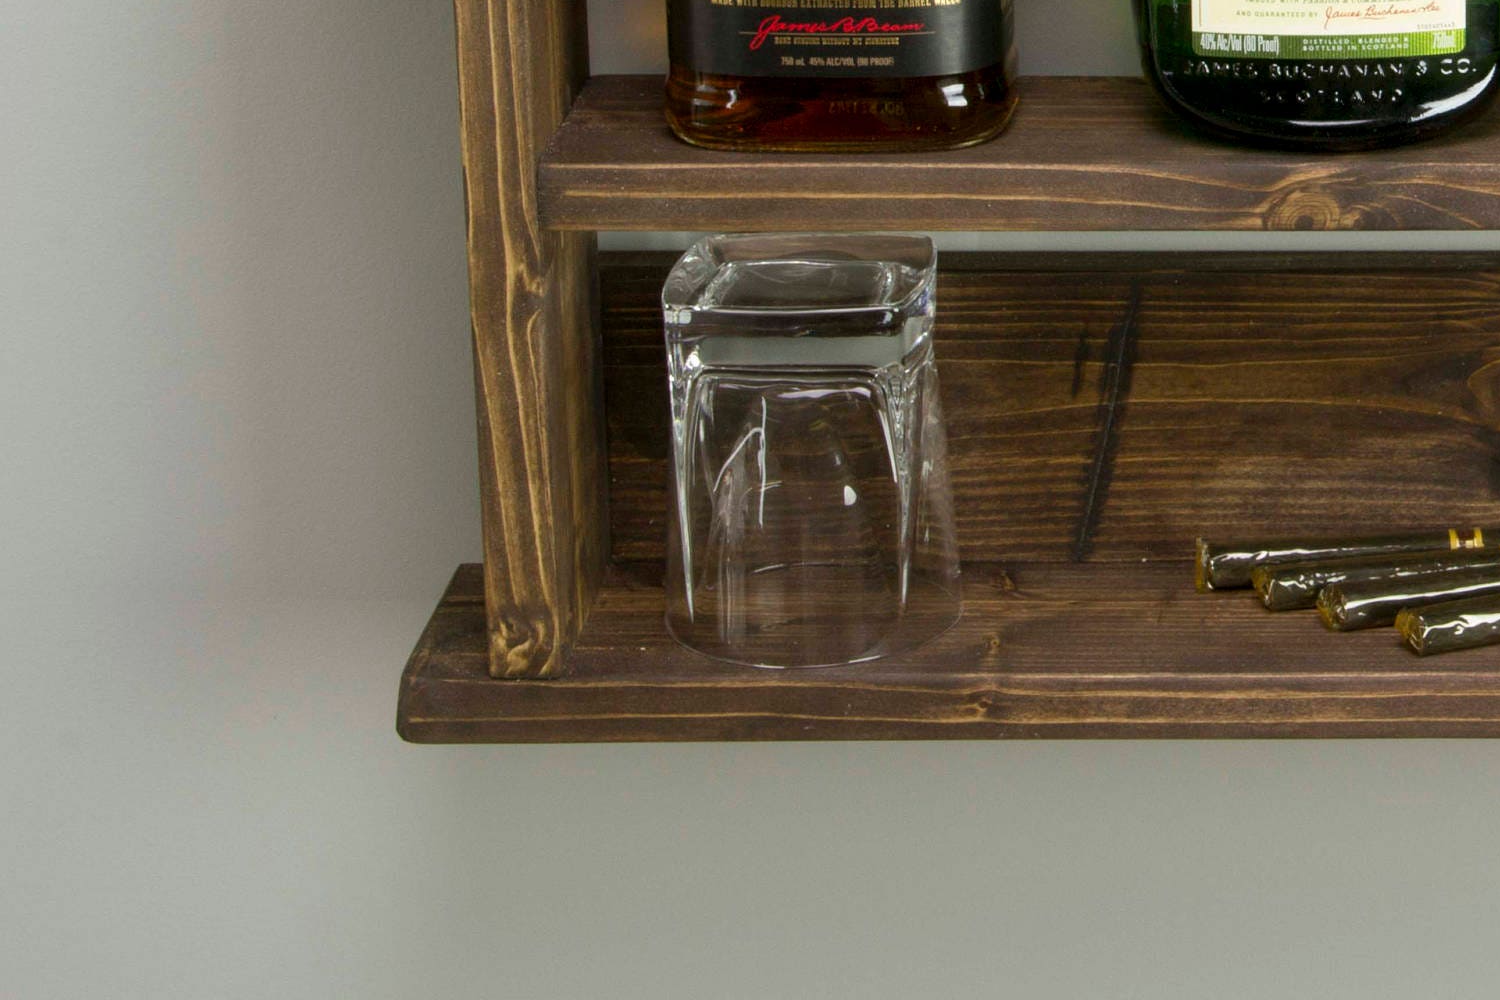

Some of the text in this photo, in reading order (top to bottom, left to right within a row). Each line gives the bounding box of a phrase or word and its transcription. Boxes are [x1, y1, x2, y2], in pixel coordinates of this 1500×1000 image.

[1200, 33, 1216, 50] 40%
[1358, 37, 1399, 45] BLENDED
[1362, 43, 1409, 51] SCOTLAND
